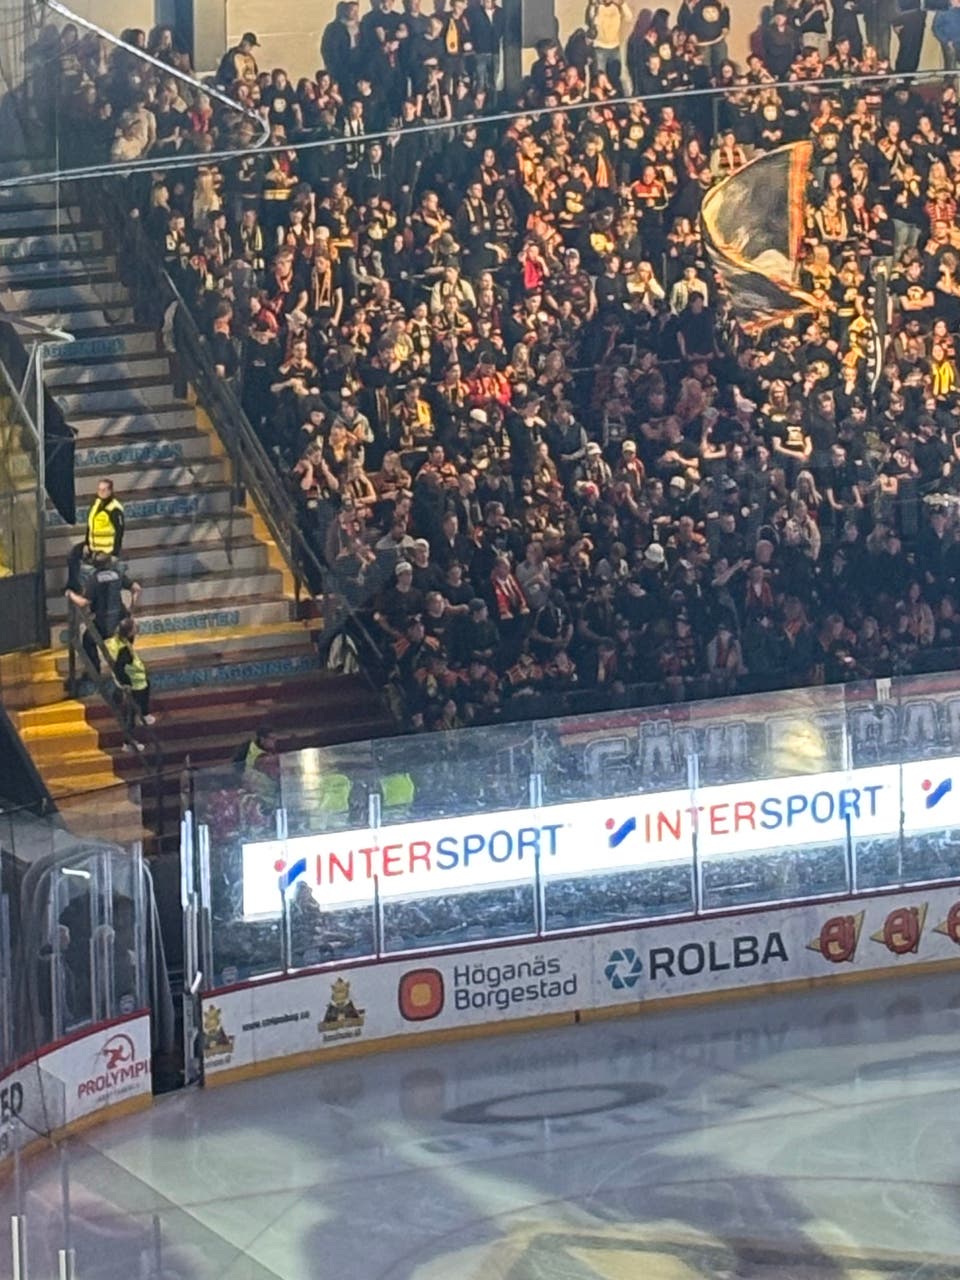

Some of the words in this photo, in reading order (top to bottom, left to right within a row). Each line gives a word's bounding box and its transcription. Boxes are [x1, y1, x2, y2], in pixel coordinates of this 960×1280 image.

[644, 784, 884, 843] INTERSPORT
[316, 823, 564, 885] INTERSPORT
[453, 955, 561, 990] Höganäs
[649, 931, 789, 980] ROLBA
[455, 975, 578, 1011] Borgestad
[78, 1059, 148, 1099] PROLYMPI
